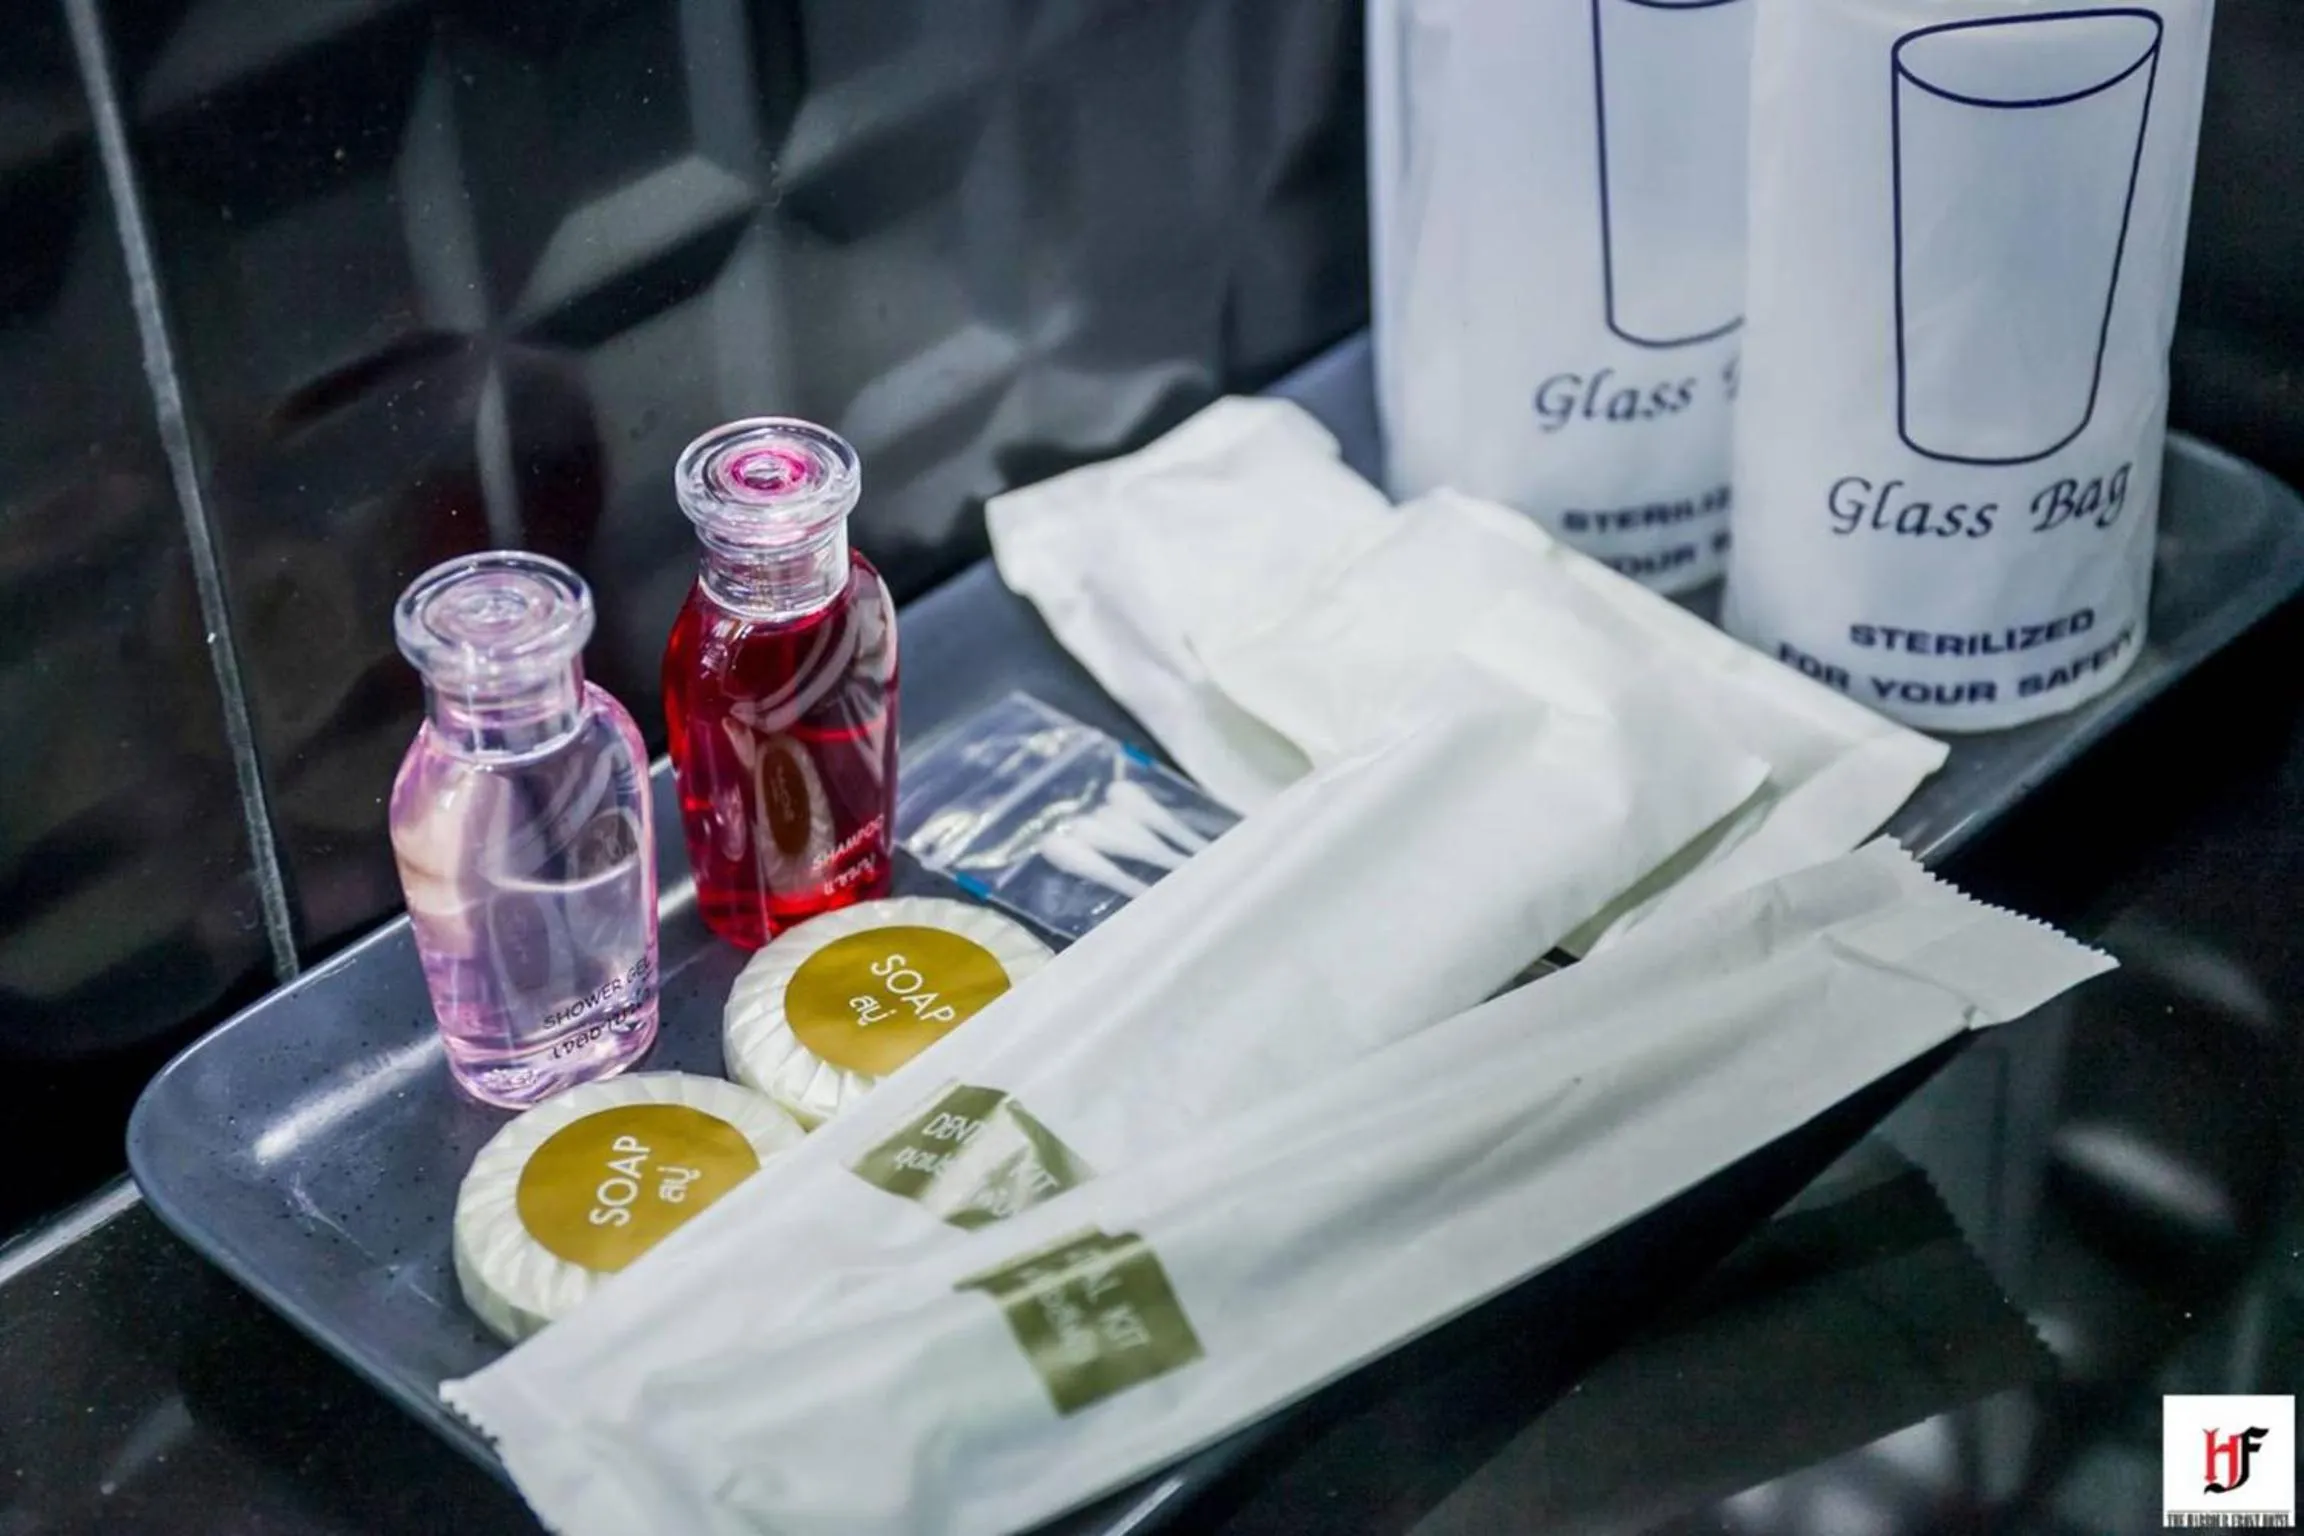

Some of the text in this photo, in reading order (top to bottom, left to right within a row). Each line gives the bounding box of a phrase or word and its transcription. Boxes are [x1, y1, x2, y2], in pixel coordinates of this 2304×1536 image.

[1534, 367, 1698, 434] Glass
[1561, 484, 1731, 534] STERILI
[1827, 461, 2133, 538] Glass Bag
[1849, 607, 2096, 656] STERILIZED
[1871, 675, 1998, 706] YOUR
[542, 956, 654, 1030] SHOWER GEL
[849, 994, 897, 1027] สบู่
[870, 954, 955, 1022] SOAP
[589, 1135, 651, 1228] SOAP
[656, 1165, 701, 1204] สบู่
